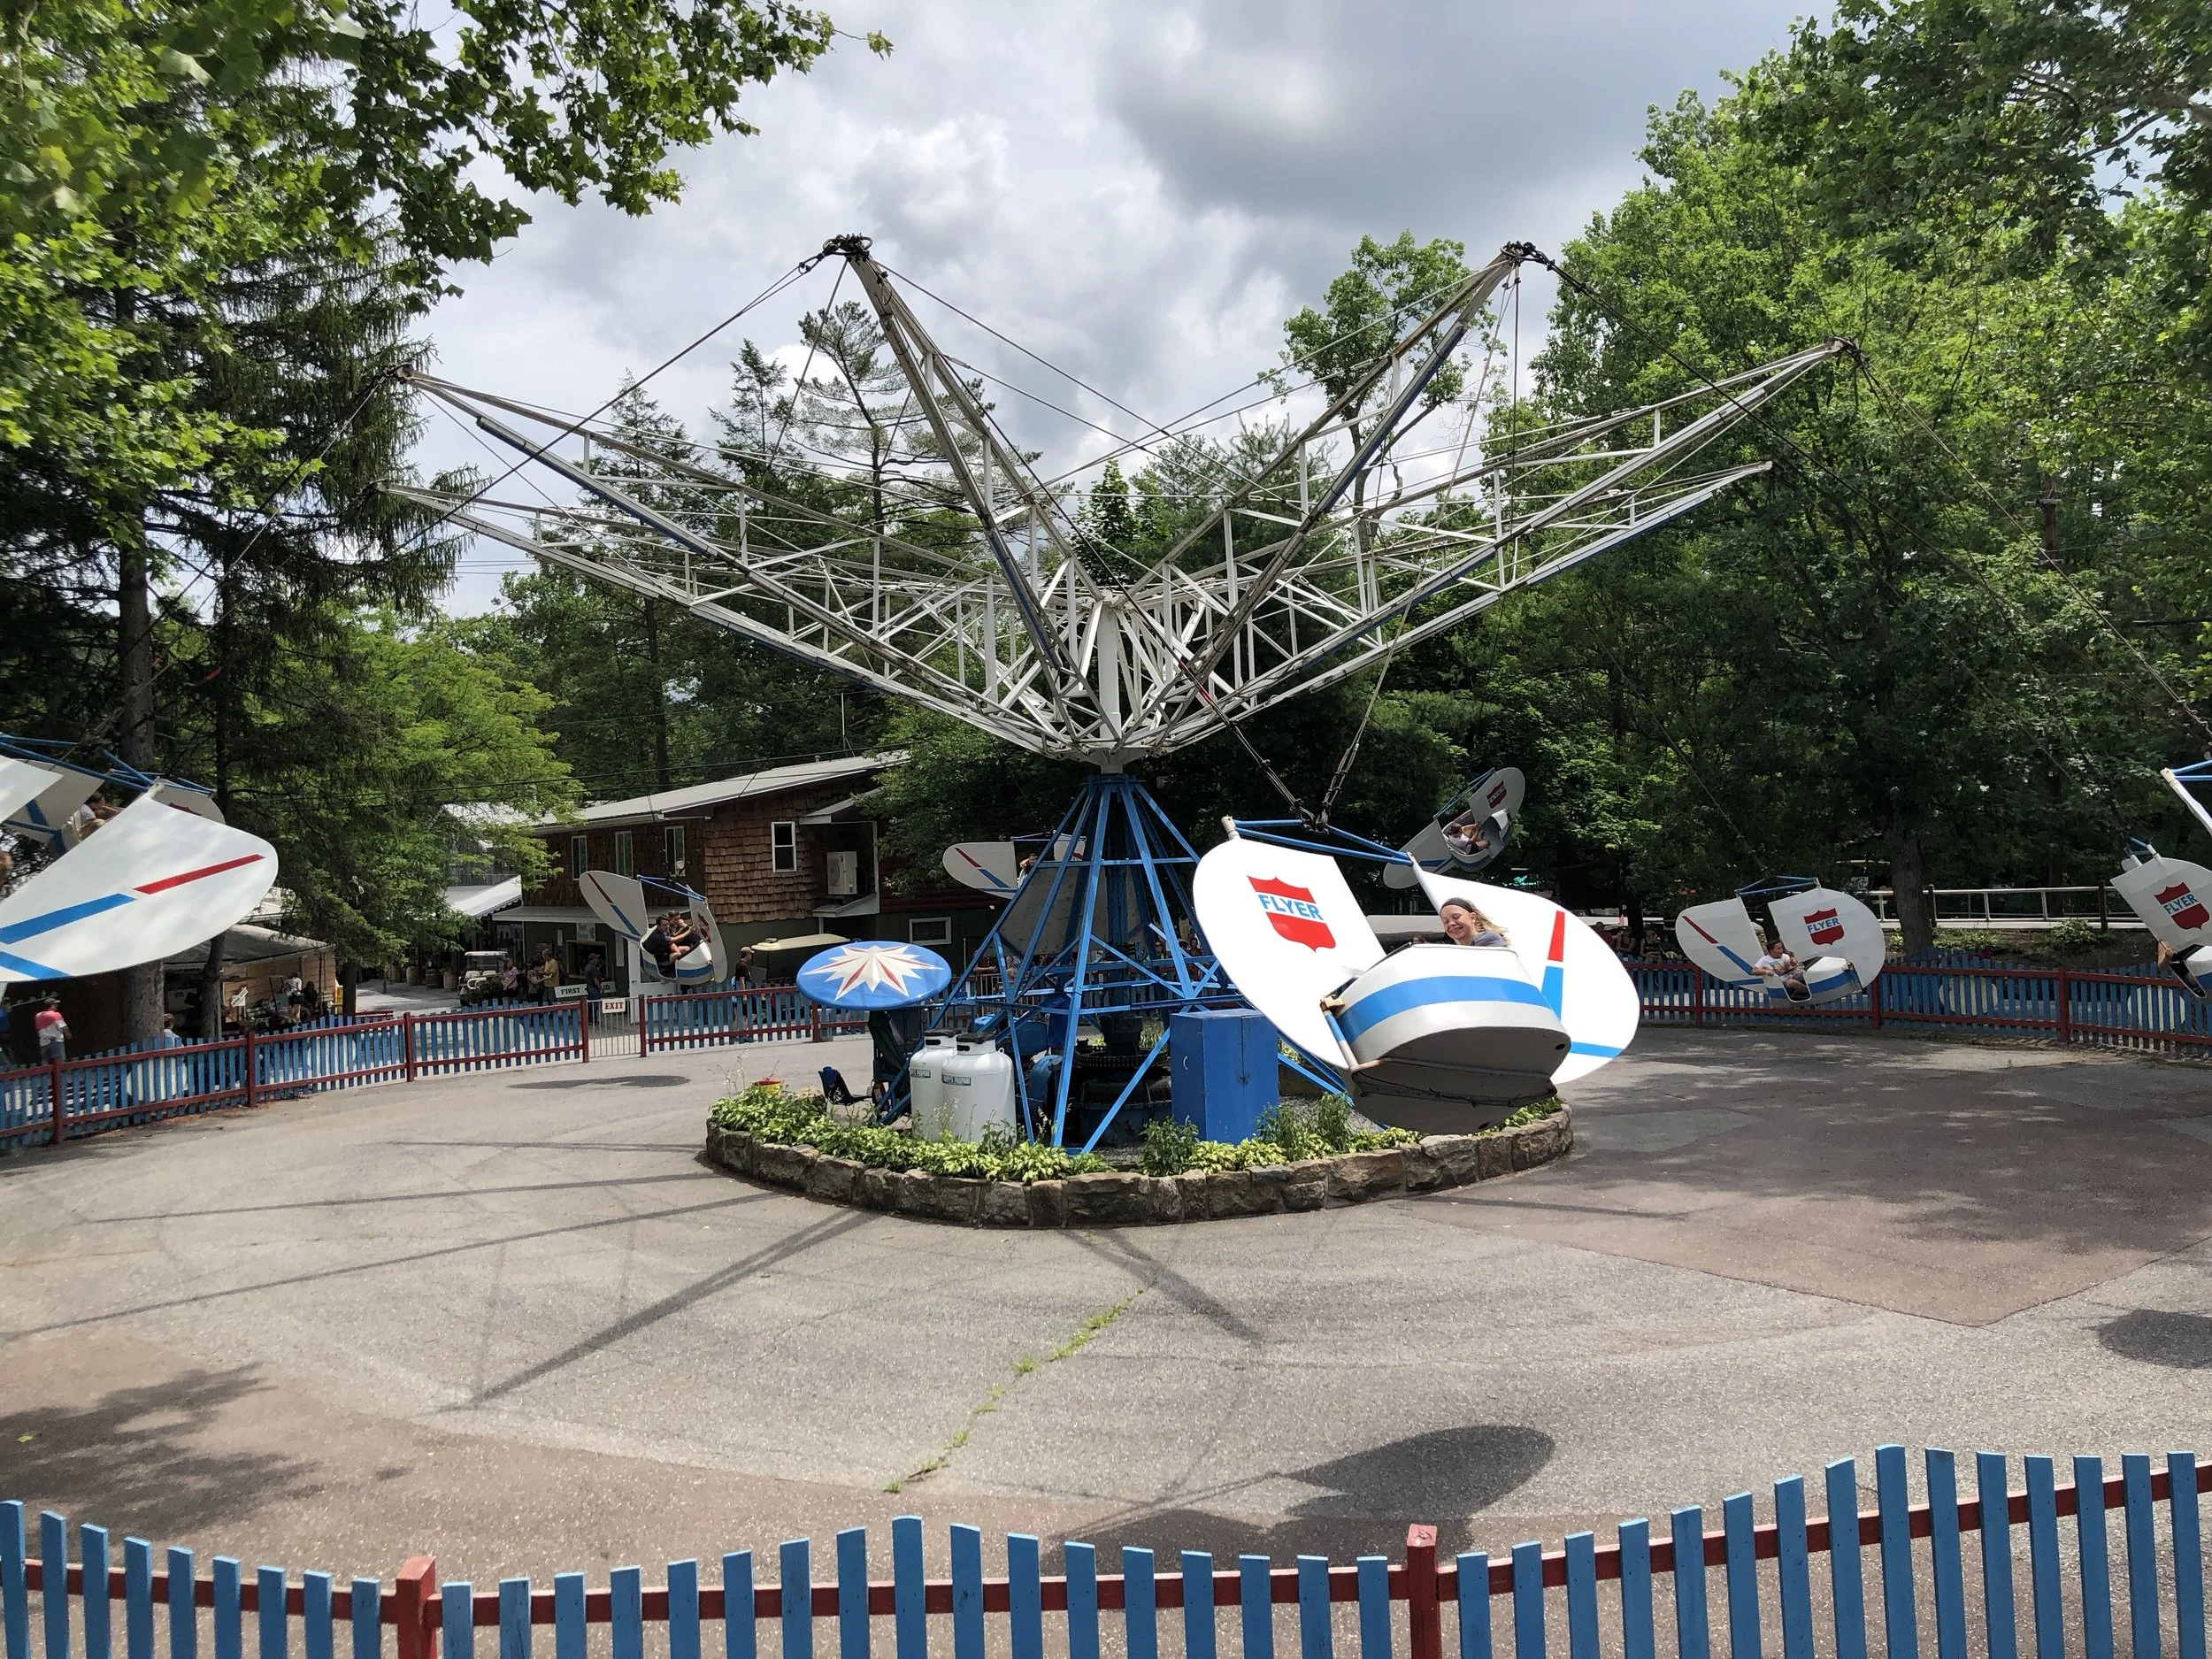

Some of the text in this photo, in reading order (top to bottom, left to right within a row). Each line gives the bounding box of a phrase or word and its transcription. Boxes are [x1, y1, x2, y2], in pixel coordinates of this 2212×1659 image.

[1258, 894, 1325, 921] FLYER
[2162, 894, 2200, 915] FLYER
[1807, 918, 1840, 933] FLYER
